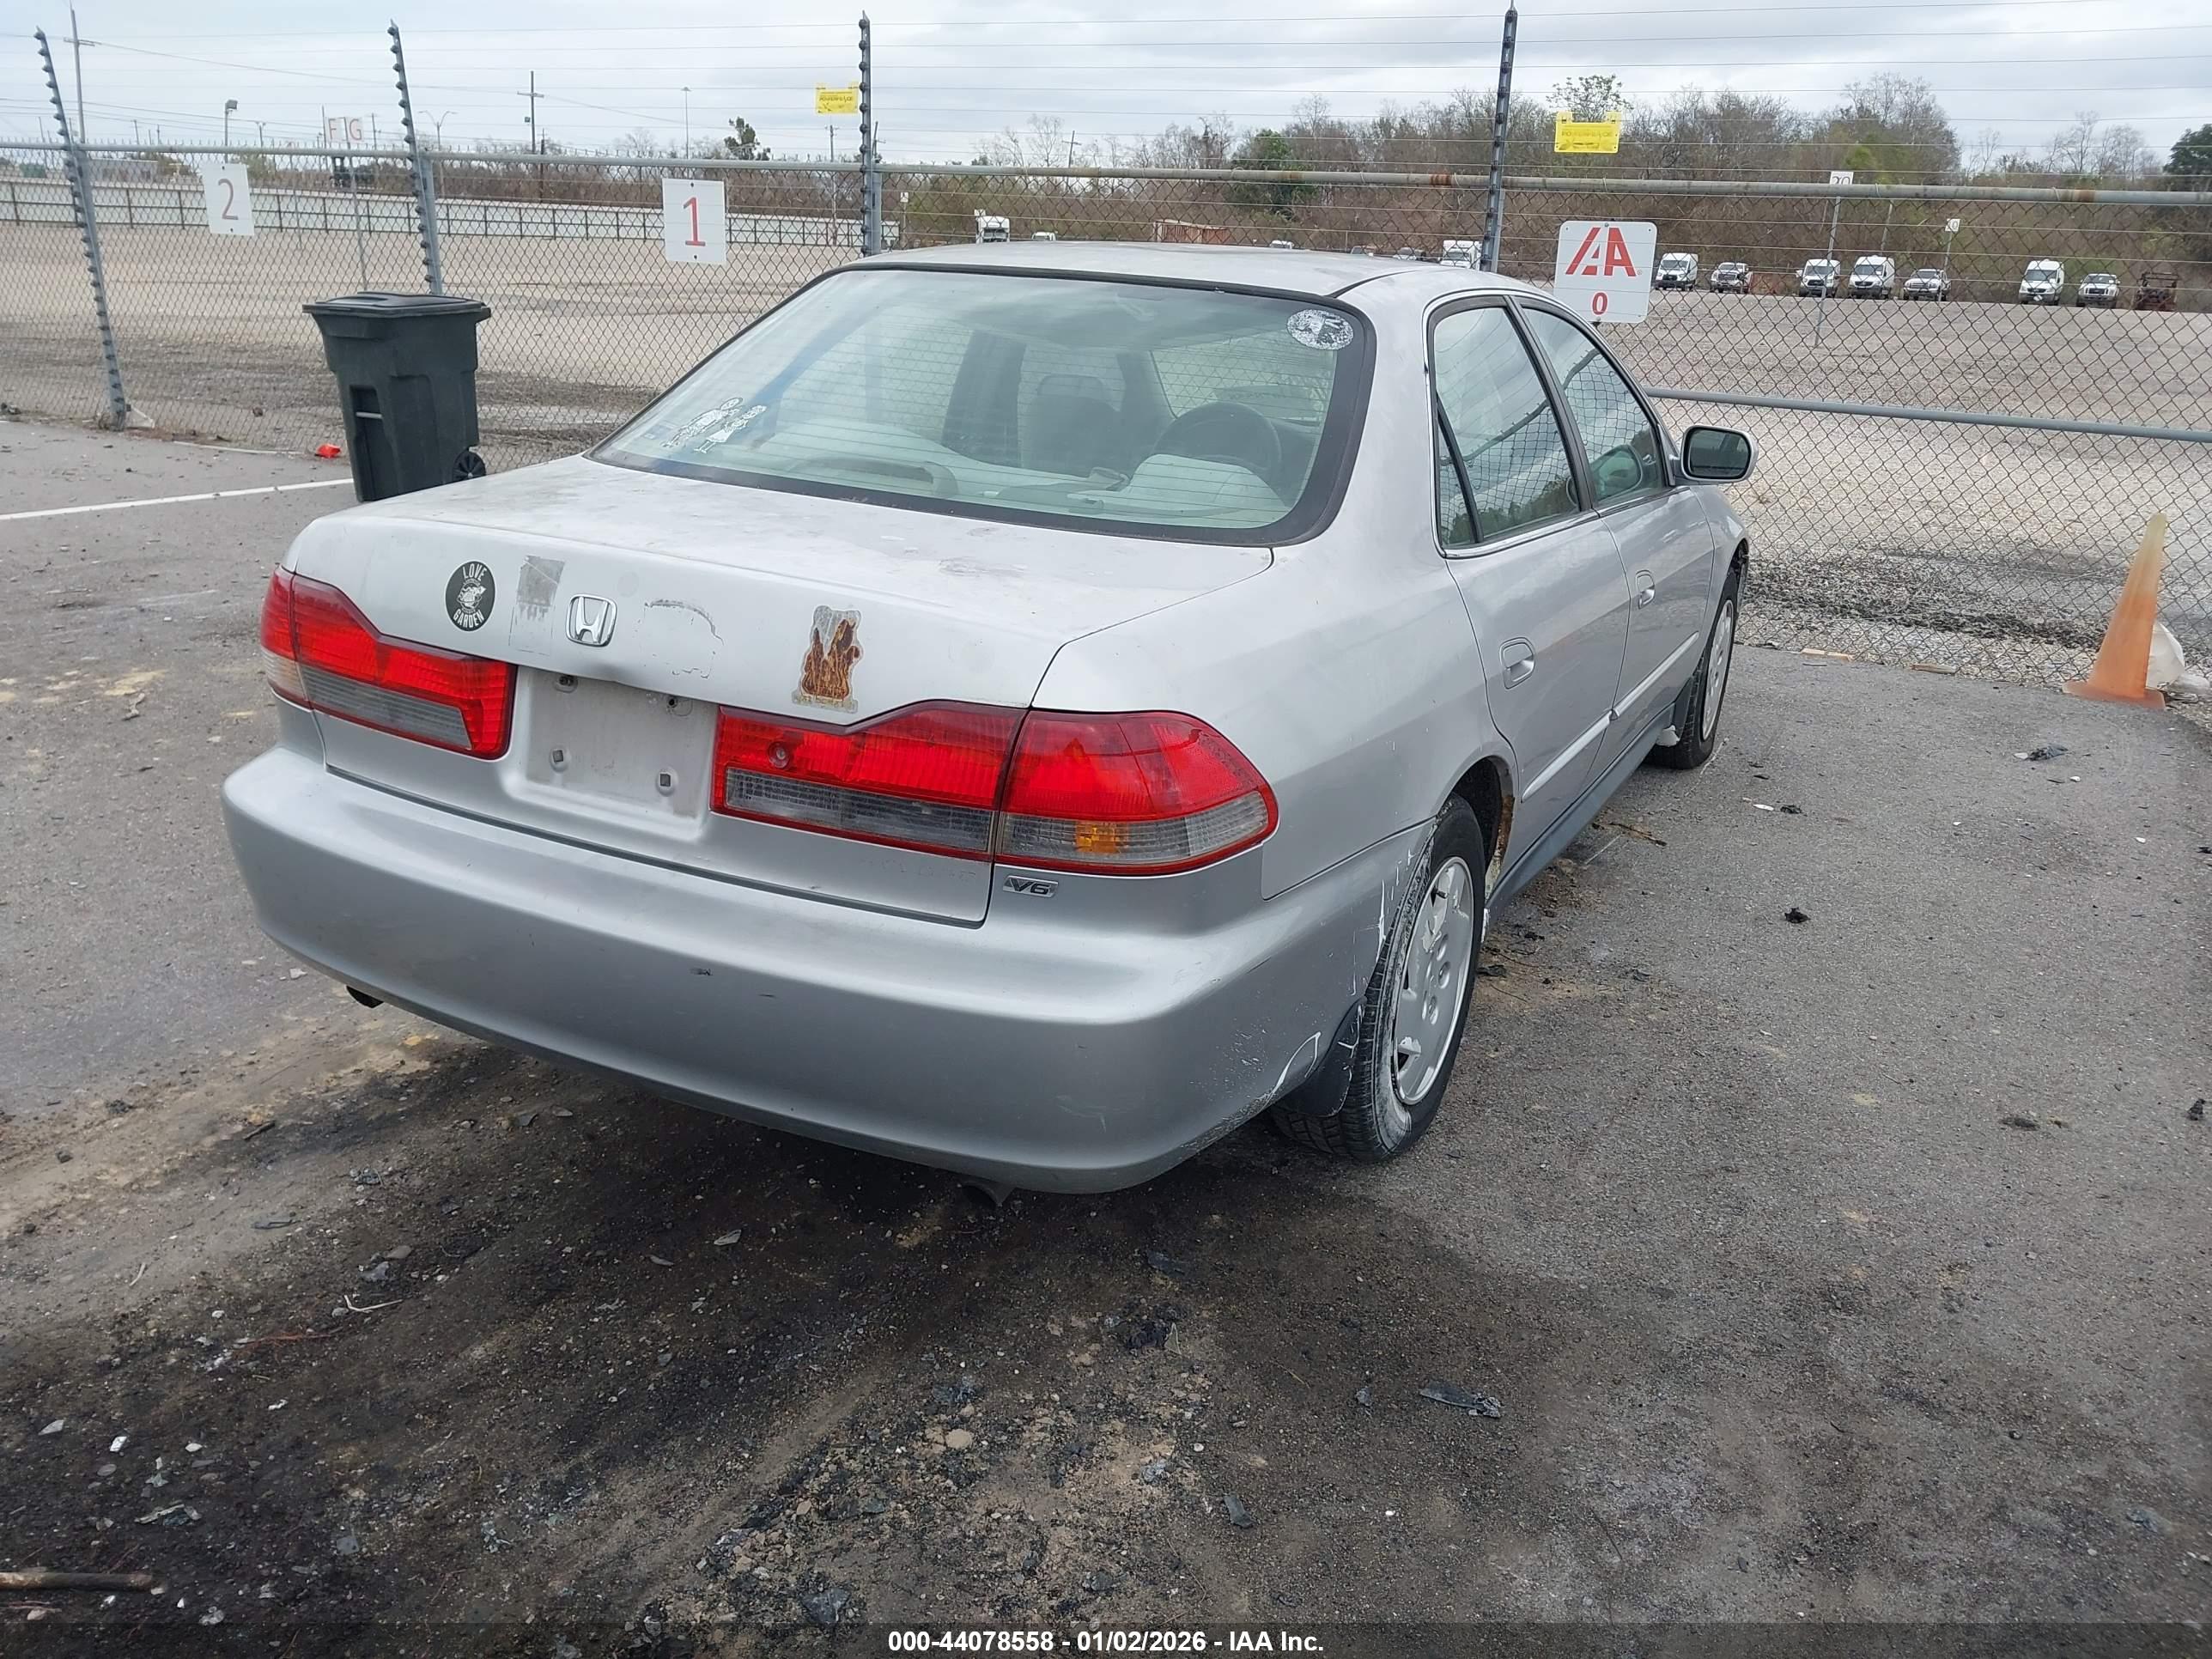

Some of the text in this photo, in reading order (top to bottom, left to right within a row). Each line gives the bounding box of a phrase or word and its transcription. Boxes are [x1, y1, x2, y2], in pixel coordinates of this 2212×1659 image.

[349, 118, 362, 141] G
[217, 178, 240, 221] 2
[683, 197, 707, 247] 1
[1592, 292, 1608, 315] 0
[462, 562, 488, 582] LOVE
[453, 608, 485, 629] GARDEN
[1009, 878, 1050, 895] V6
